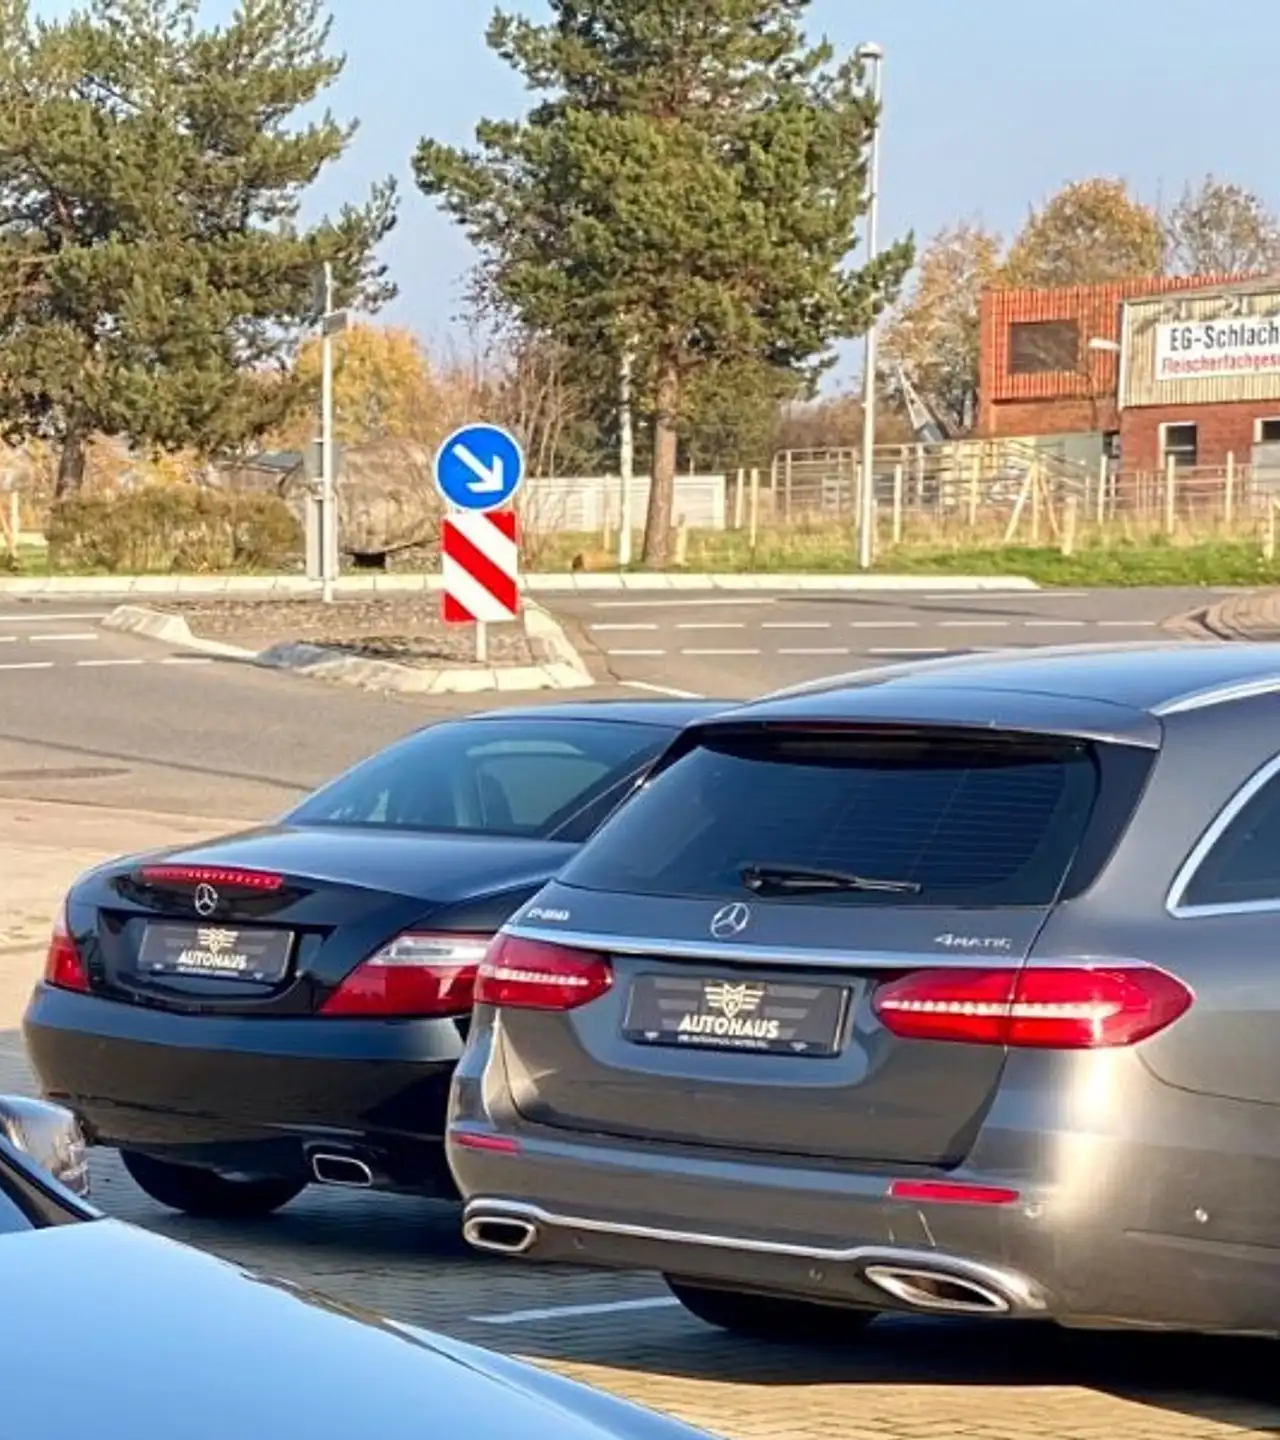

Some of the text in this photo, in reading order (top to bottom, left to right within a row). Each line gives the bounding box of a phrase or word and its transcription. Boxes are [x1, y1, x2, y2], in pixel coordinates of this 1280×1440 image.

[1169, 319, 1279, 352] EG-Schlach
[933, 933, 1012, 950] 4MATIC
[176, 949, 248, 970] AUTOHAUS
[677, 1014, 781, 1039] AUTOHAUS
